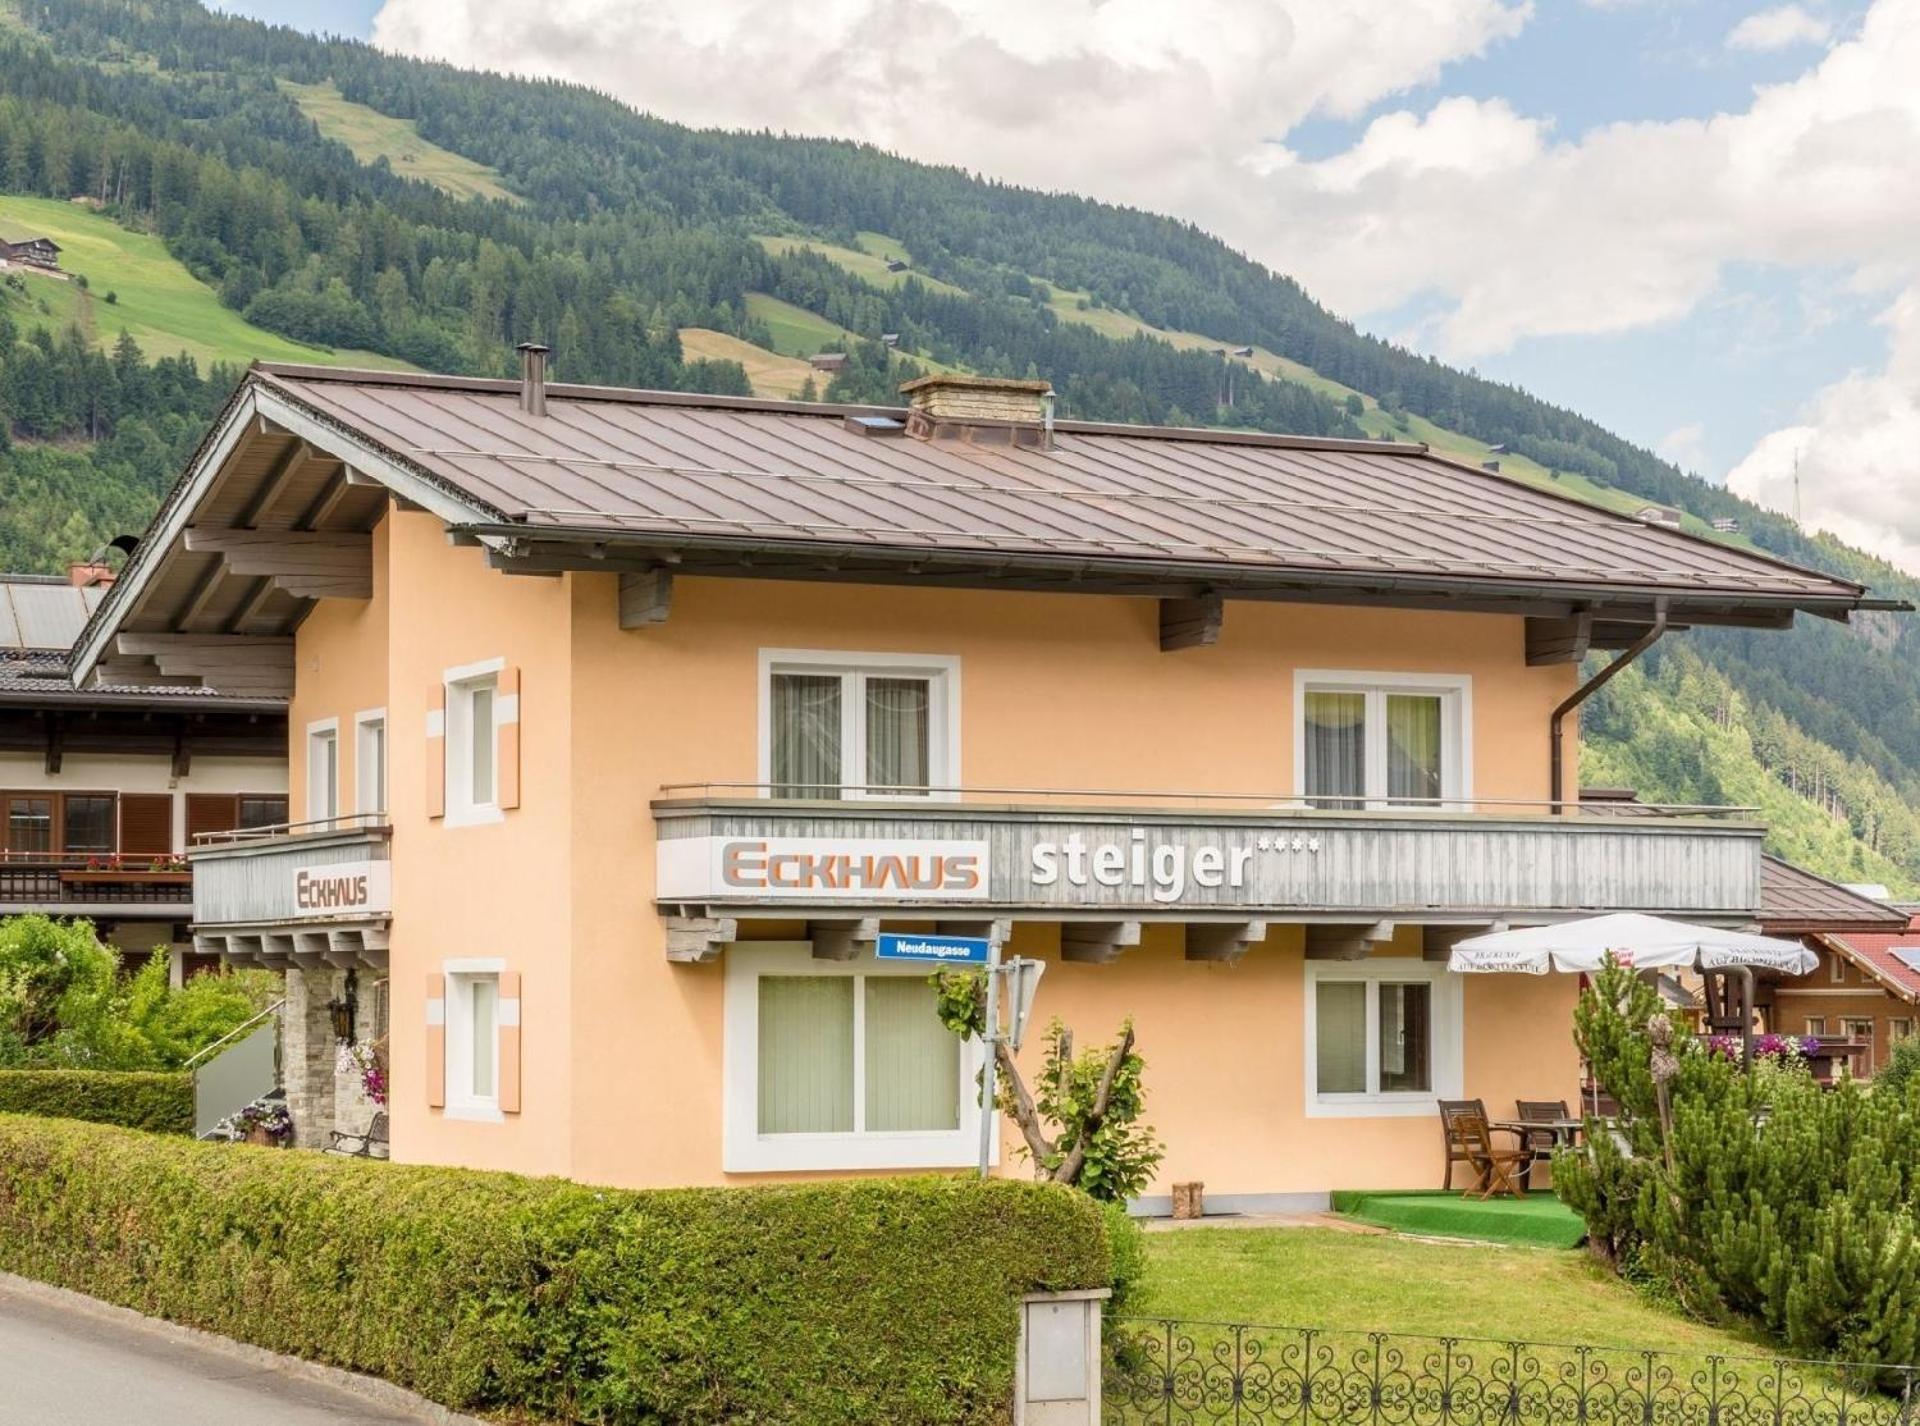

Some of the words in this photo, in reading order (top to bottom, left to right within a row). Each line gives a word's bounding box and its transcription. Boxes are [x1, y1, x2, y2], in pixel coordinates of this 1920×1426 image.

[722, 842, 979, 890] ECKHAUS
[1031, 828, 1252, 902] steiger
[297, 871, 367, 908] ECKHAUS
[896, 940, 971, 957] Neudaugasse
